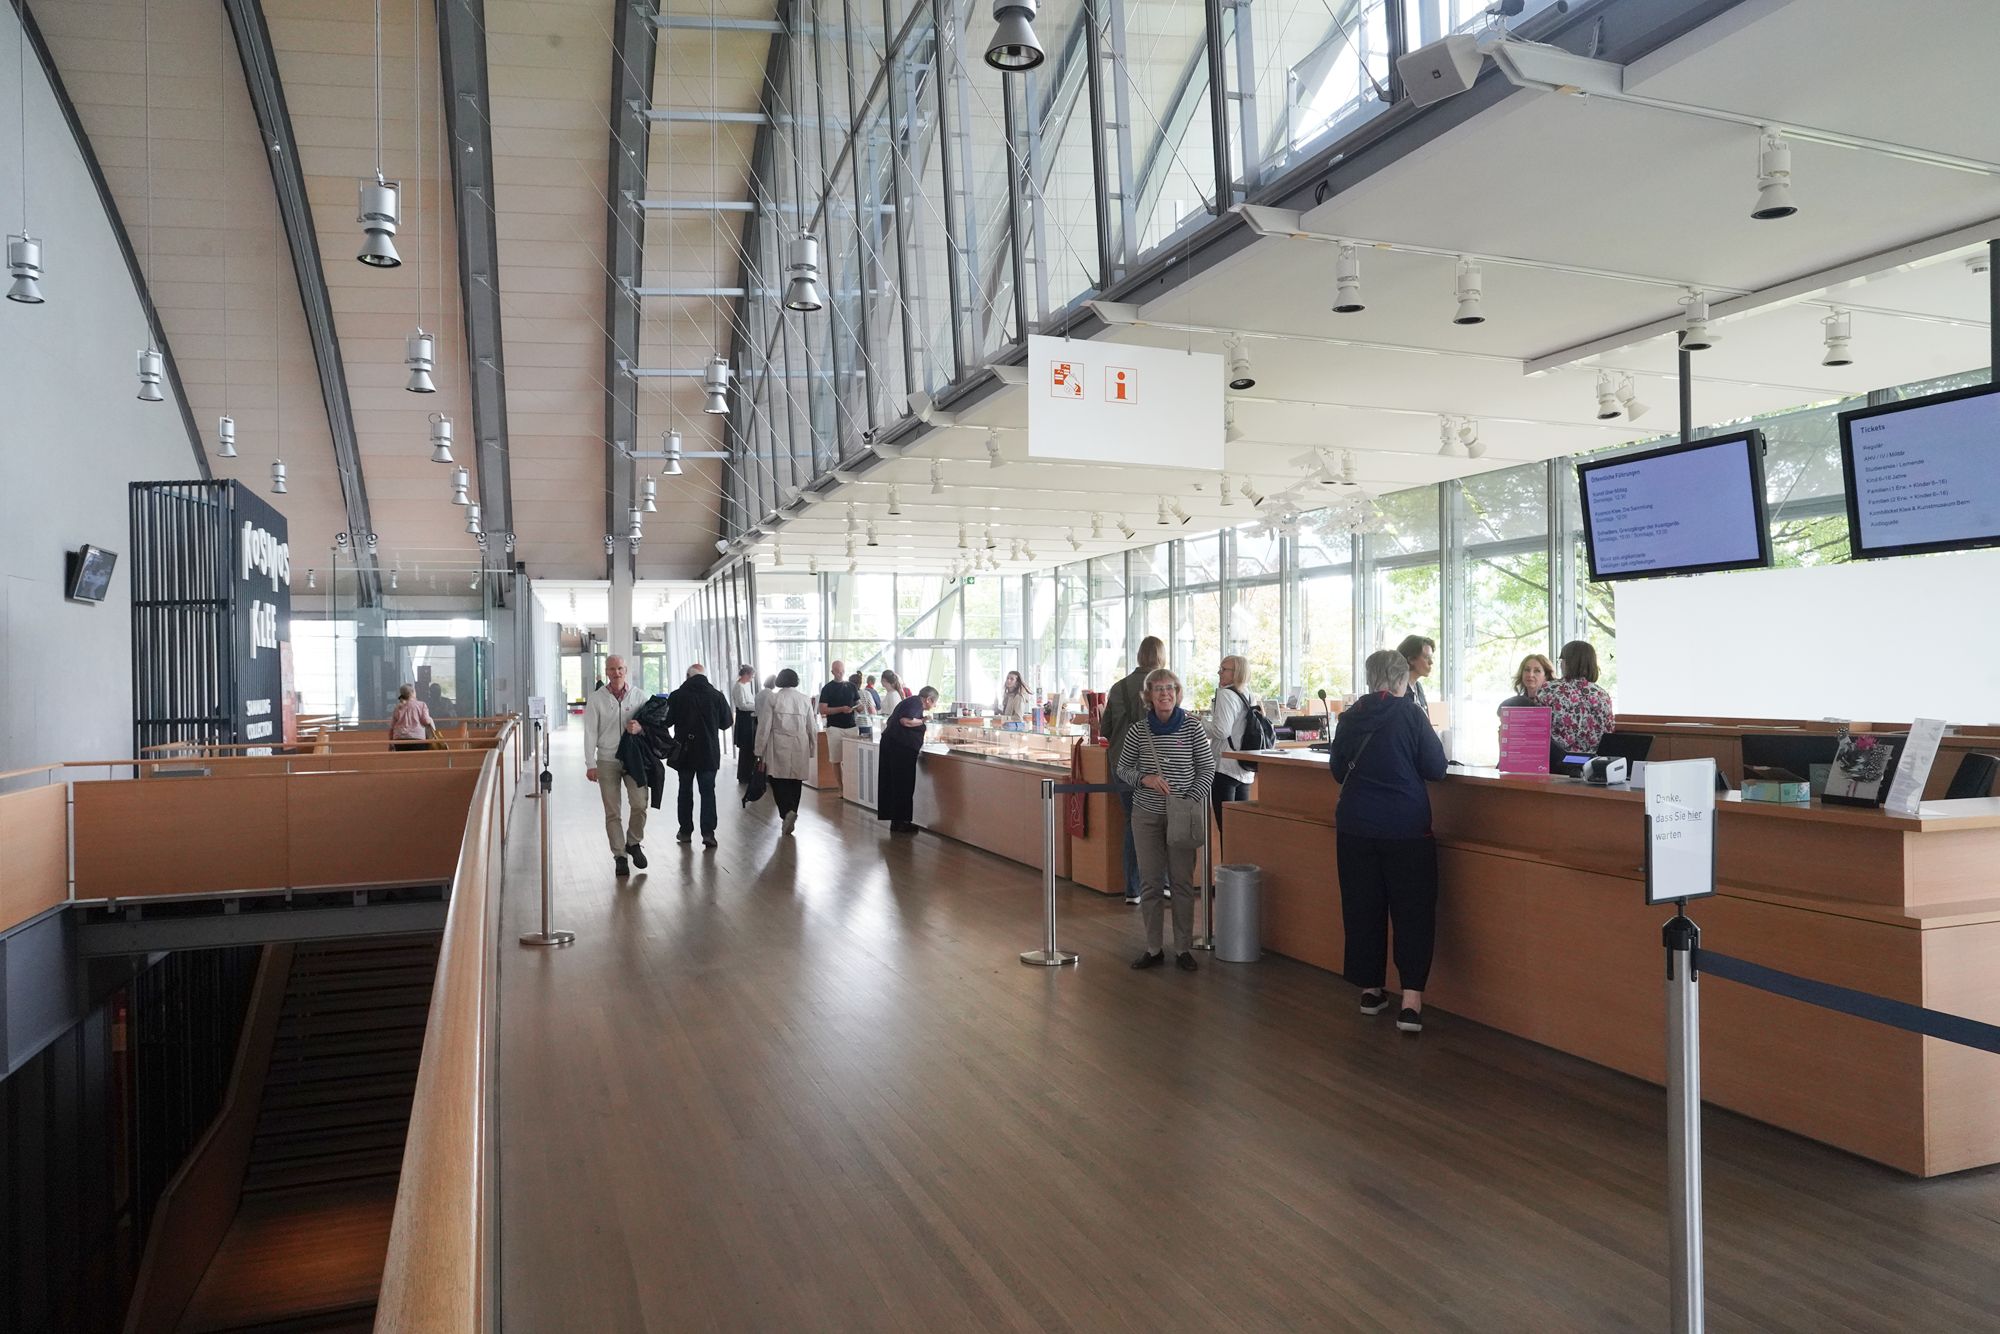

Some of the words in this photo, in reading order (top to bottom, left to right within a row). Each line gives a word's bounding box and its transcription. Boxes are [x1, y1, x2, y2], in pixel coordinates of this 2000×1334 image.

[1860, 424, 1886, 433] Tickets
[1870, 519, 1898, 527] Audioguide
[242, 520, 290, 593] KOSMOS
[249, 600, 277, 659] KLEE
[1656, 793, 1682, 804] Danke,
[1655, 812, 1673, 823] dass
[1674, 811, 1686, 821] Sie
[1687, 810, 1702, 820] hier
[1655, 830, 1682, 840] warten
